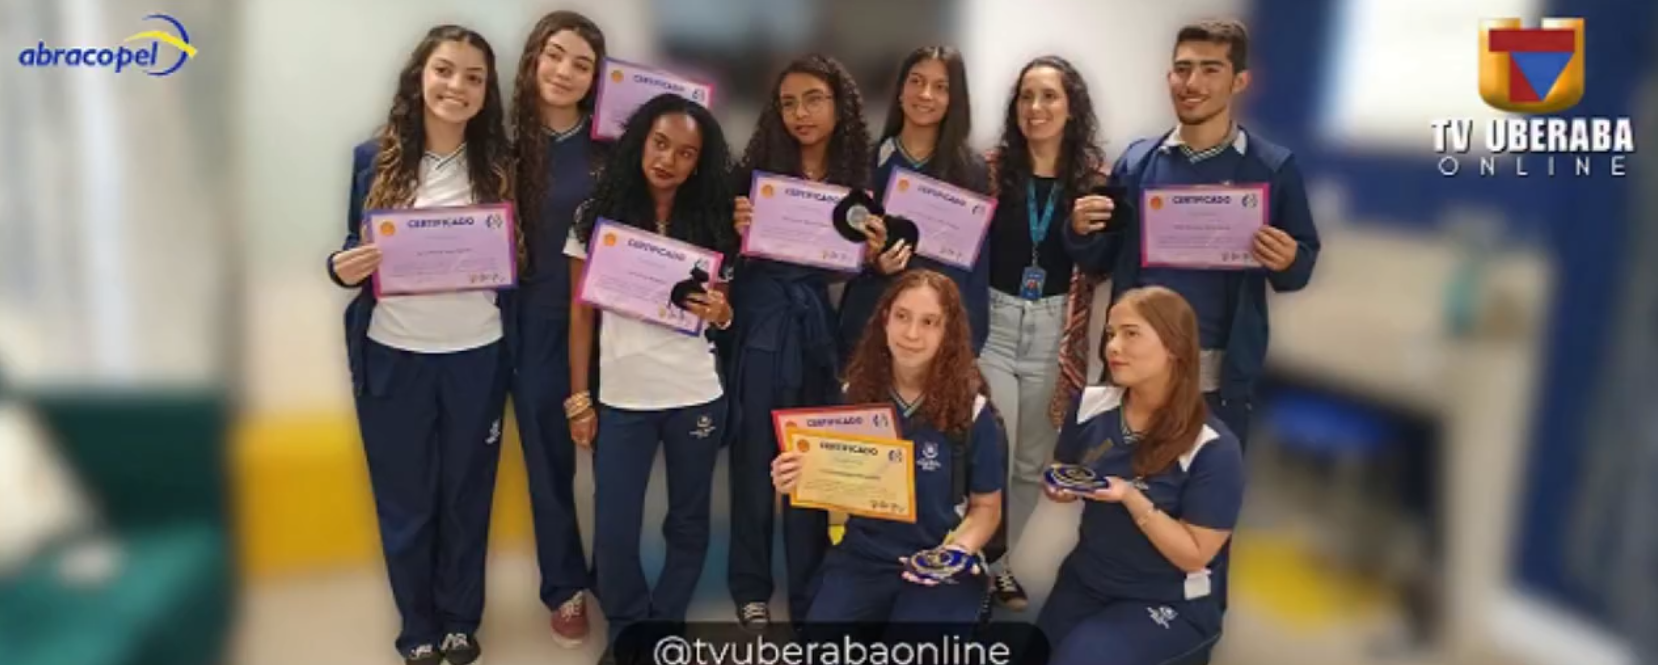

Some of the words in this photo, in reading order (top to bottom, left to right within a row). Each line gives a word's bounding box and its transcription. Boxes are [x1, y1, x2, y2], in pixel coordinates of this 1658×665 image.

[1171, 194, 1232, 205] CERTIFICADO
[407, 217, 474, 228] CERTIFICADO
[627, 237, 687, 261] CERTIFICADO
[806, 416, 863, 427] CERTIFICADO
[819, 442, 878, 456] CERTIFICADO
